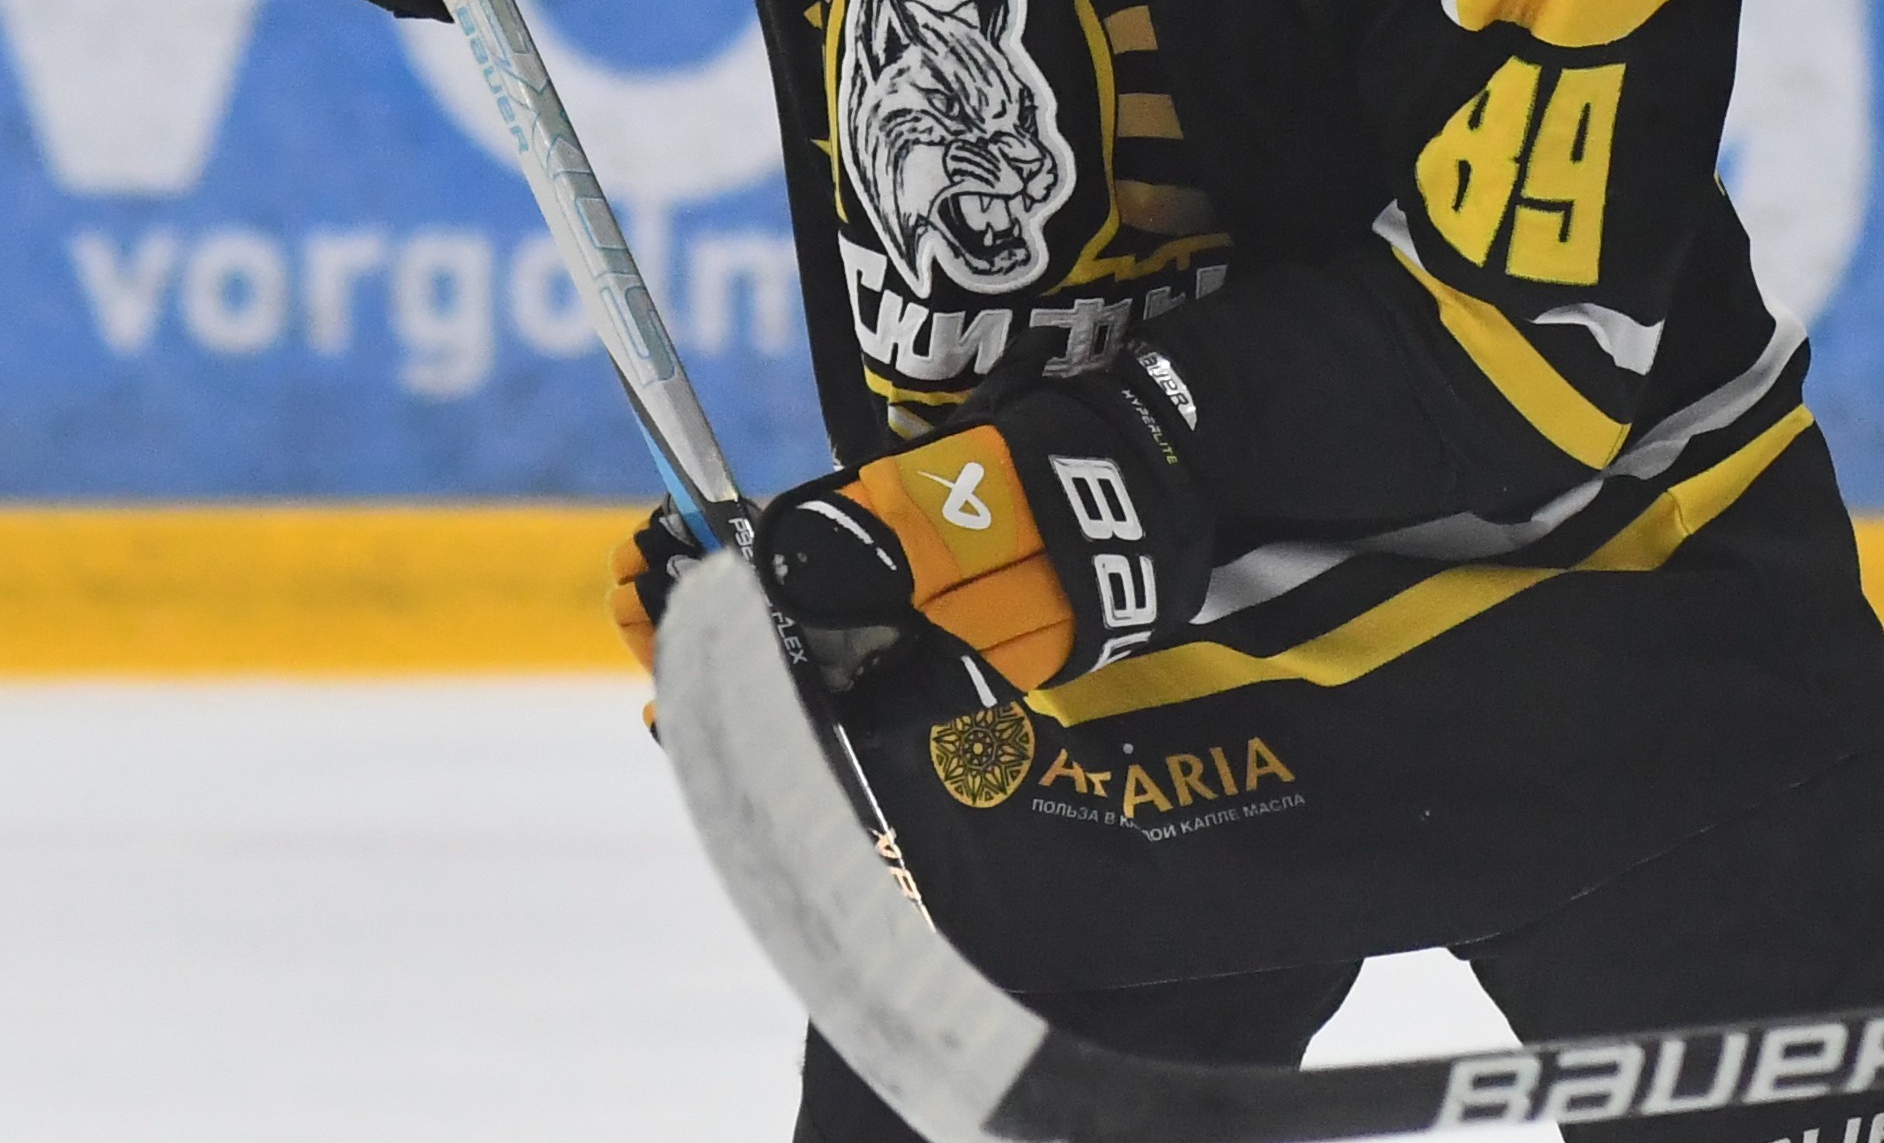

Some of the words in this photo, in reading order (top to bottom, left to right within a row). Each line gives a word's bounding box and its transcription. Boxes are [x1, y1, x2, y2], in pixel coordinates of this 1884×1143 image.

[1414, 54, 1628, 287] 89
[1121, 388, 1178, 465] HYPERLITE
[1031, 798, 1099, 823] ПОЛЬЗА
[1104, 811, 1116, 826] В
[1180, 807, 1240, 834] КАПЛЕ
[1244, 792, 1307, 819] МАСЛА
